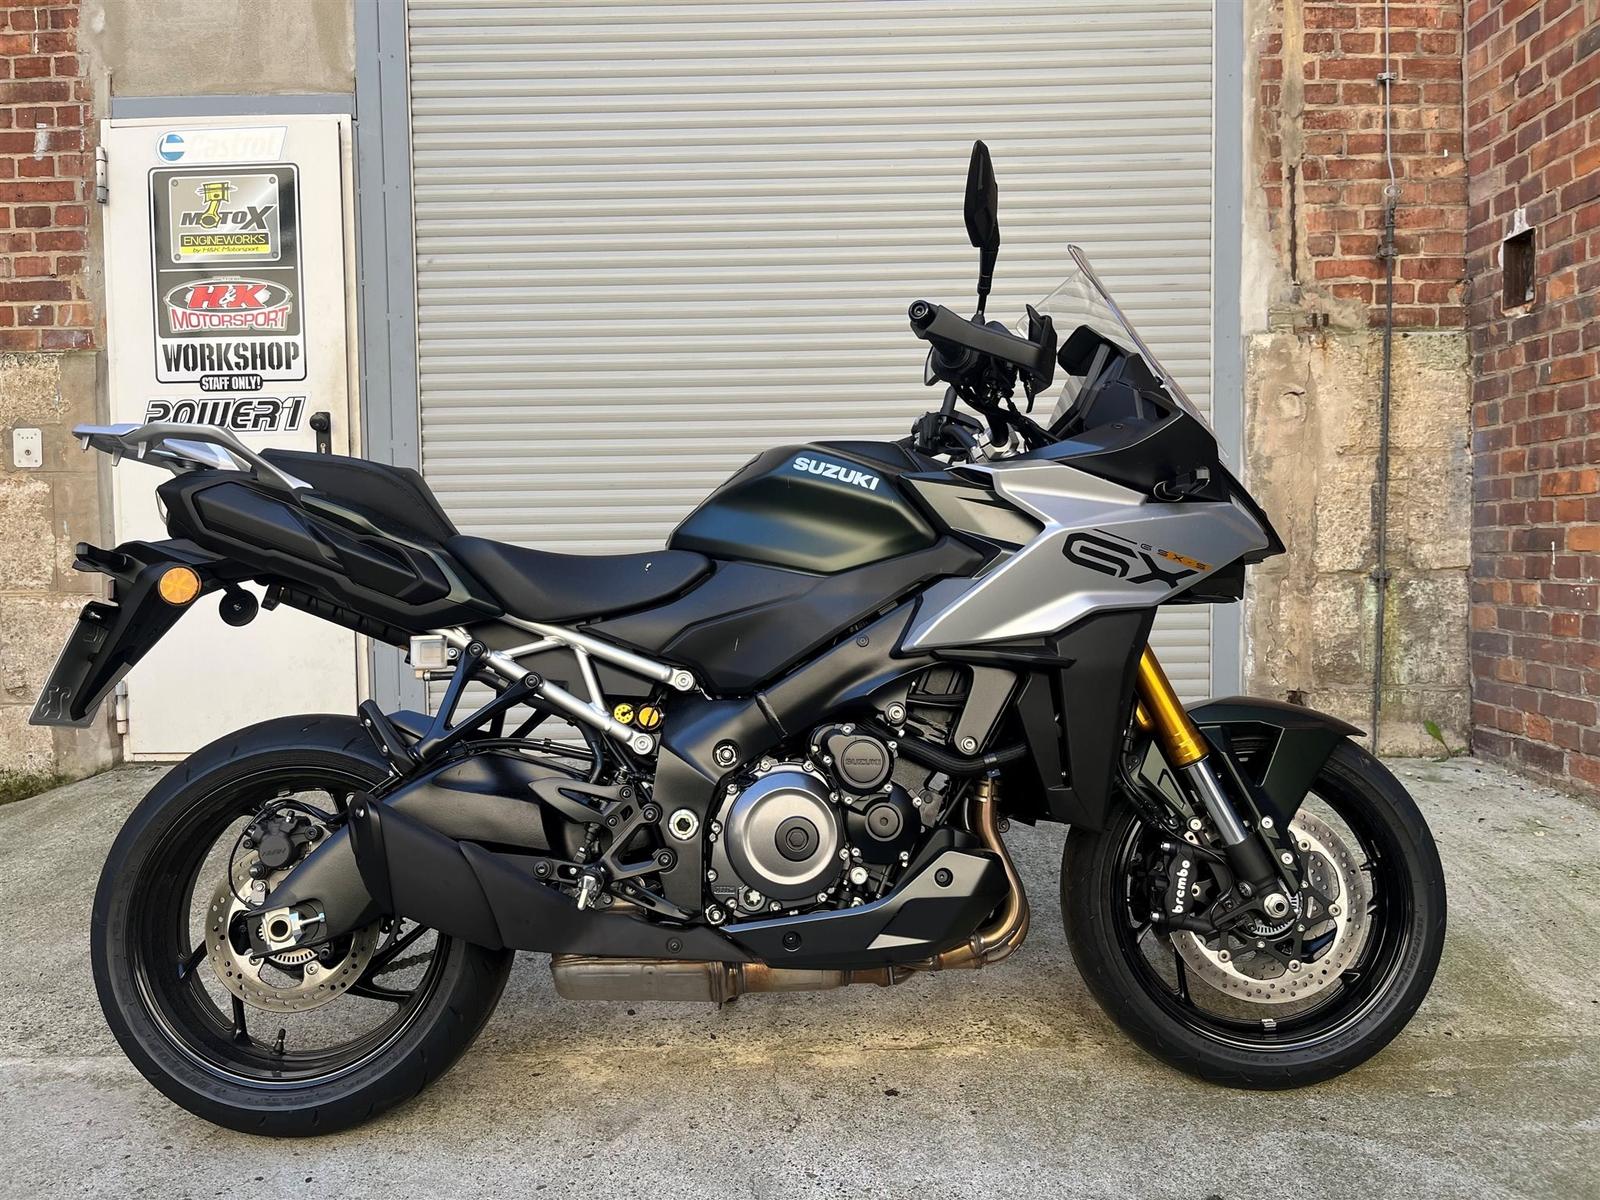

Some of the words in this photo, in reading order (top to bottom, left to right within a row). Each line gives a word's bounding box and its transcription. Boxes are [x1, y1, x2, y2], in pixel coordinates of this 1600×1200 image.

[183, 234, 266, 246] ENGINEWORKS
[187, 284, 267, 309] H&K
[171, 306, 289, 330] MOTORSPORT
[162, 341, 300, 372] WORKSHOP
[202, 377, 230, 390] STAFF
[232, 376, 261, 390] ONLY!
[145, 397, 306, 431] POWER1
[793, 457, 880, 491] SUZUKI
[1171, 860, 1190, 914] brembo
